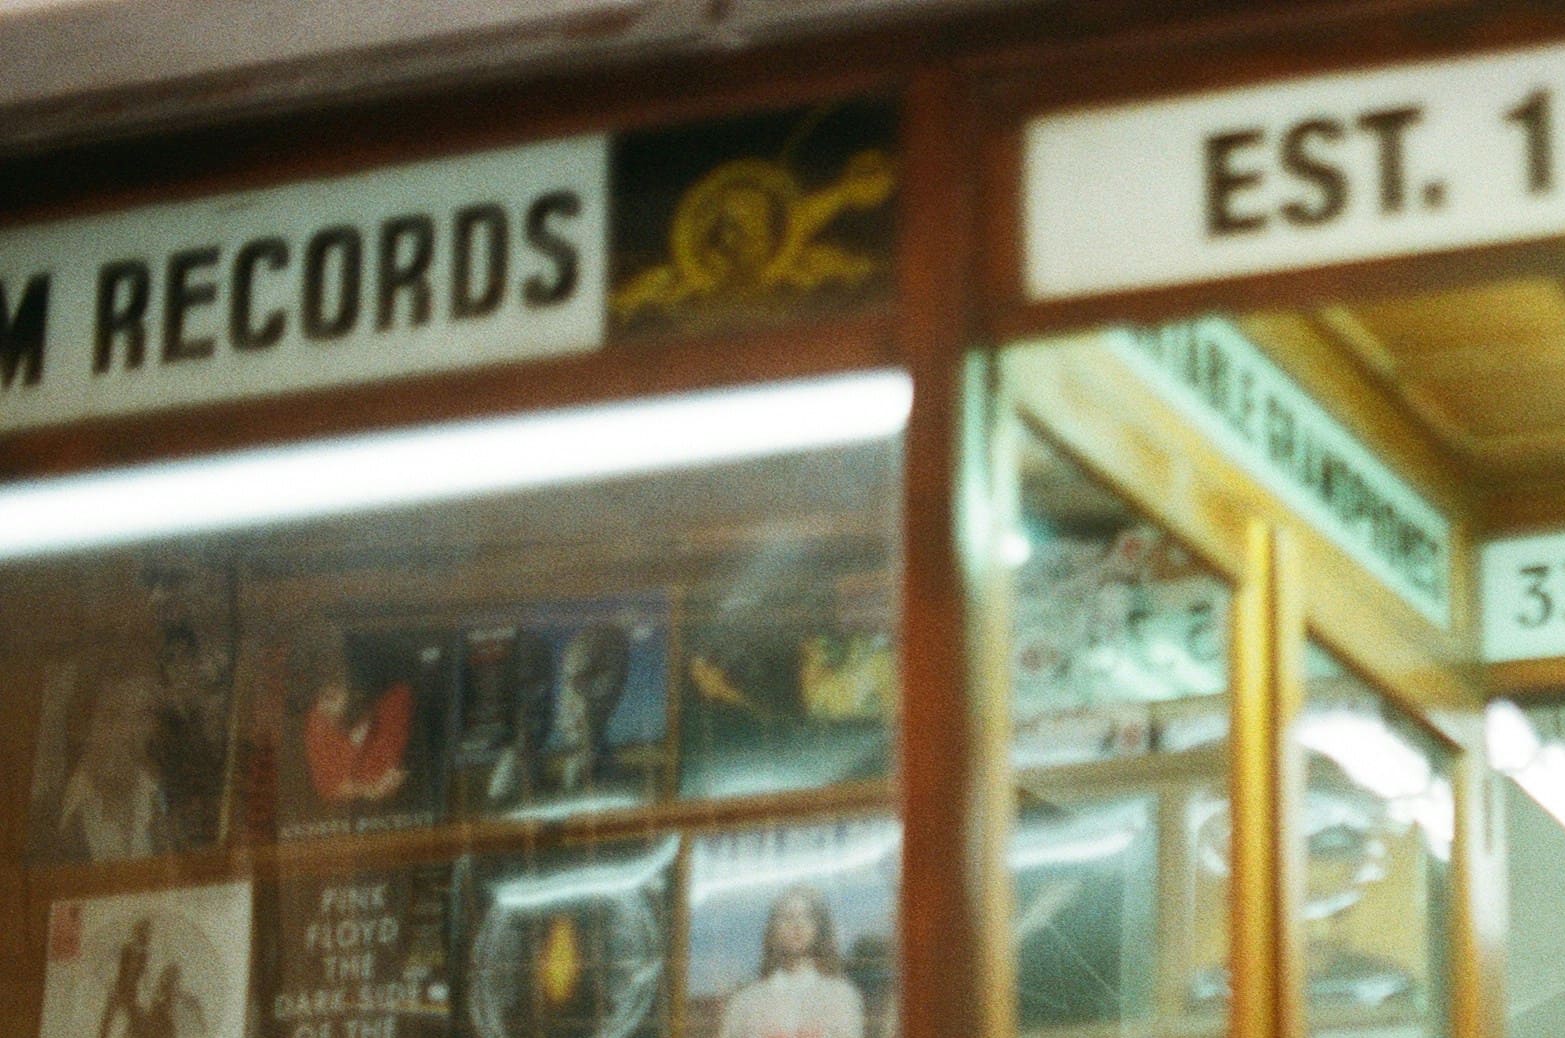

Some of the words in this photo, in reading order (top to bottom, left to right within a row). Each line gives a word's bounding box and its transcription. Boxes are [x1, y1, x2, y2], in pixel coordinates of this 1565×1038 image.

[1202, 101, 1449, 238] EST.
[92, 189, 584, 377] RECORDS
[305, 916, 399, 949] FLOYD
[322, 950, 374, 979] THE
[273, 985, 347, 1020] DARK
